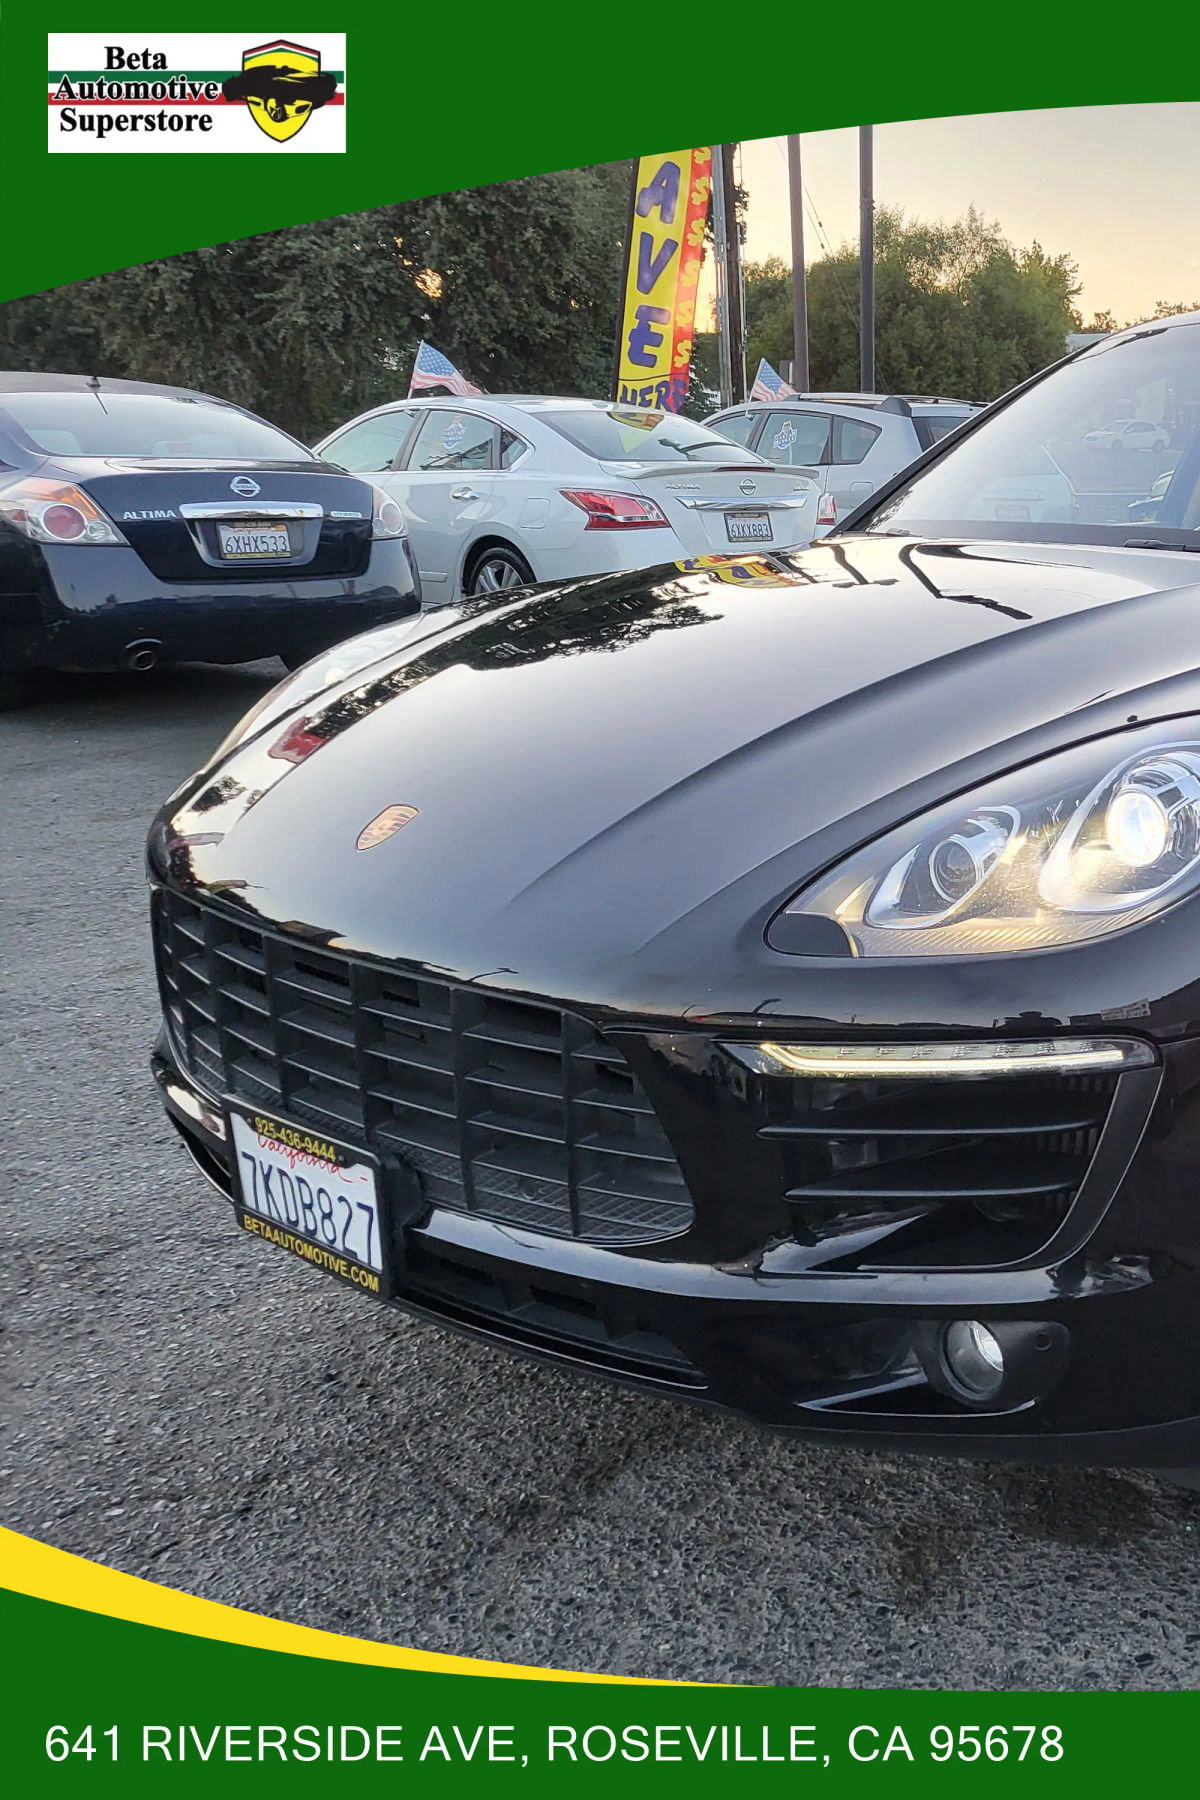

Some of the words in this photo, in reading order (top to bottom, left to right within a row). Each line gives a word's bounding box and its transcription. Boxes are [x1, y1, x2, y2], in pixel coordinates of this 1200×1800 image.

[123, 509, 177, 520] ALTIMA
[225, 535, 288, 553] 6XHX533
[254, 1116, 337, 1162] 925-436-9444
[241, 1150, 375, 1268] 7KDB827
[243, 1214, 380, 1293] BETAAUTOMOTIVE.COM
